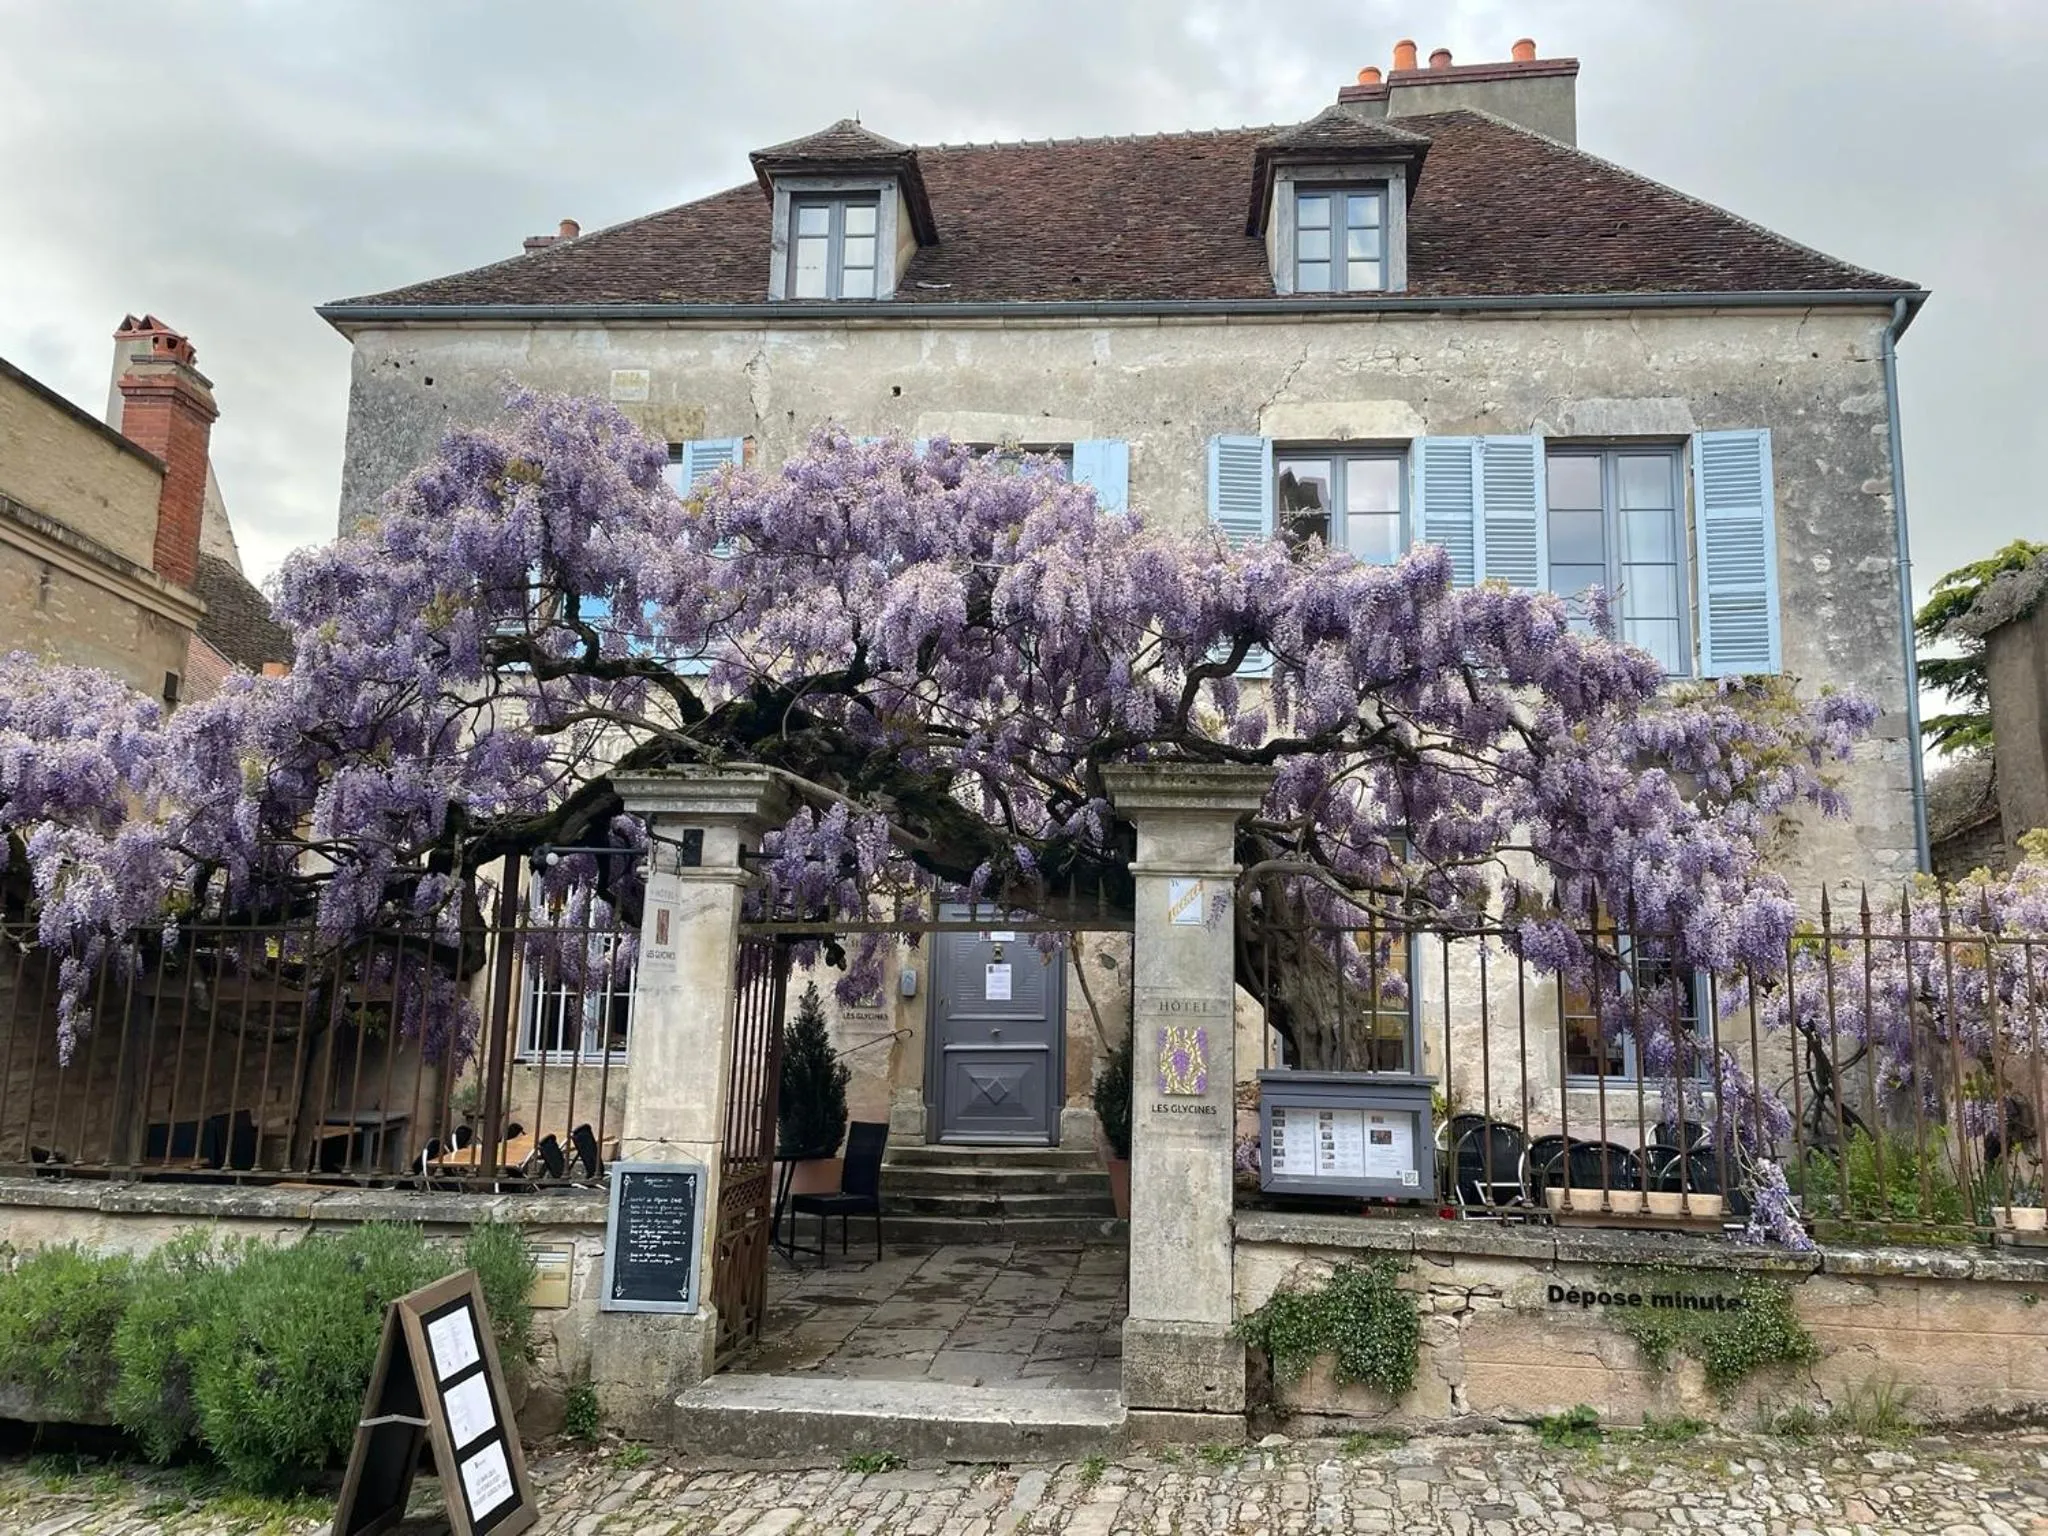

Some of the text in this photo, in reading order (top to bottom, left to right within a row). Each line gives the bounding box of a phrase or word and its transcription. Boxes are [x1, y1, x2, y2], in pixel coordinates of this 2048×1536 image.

[1159, 1000, 1208, 1012] HÔTEL
[1151, 1104, 1217, 1115] LES GLYCINES
[1548, 1285, 1643, 1308] Dépose
